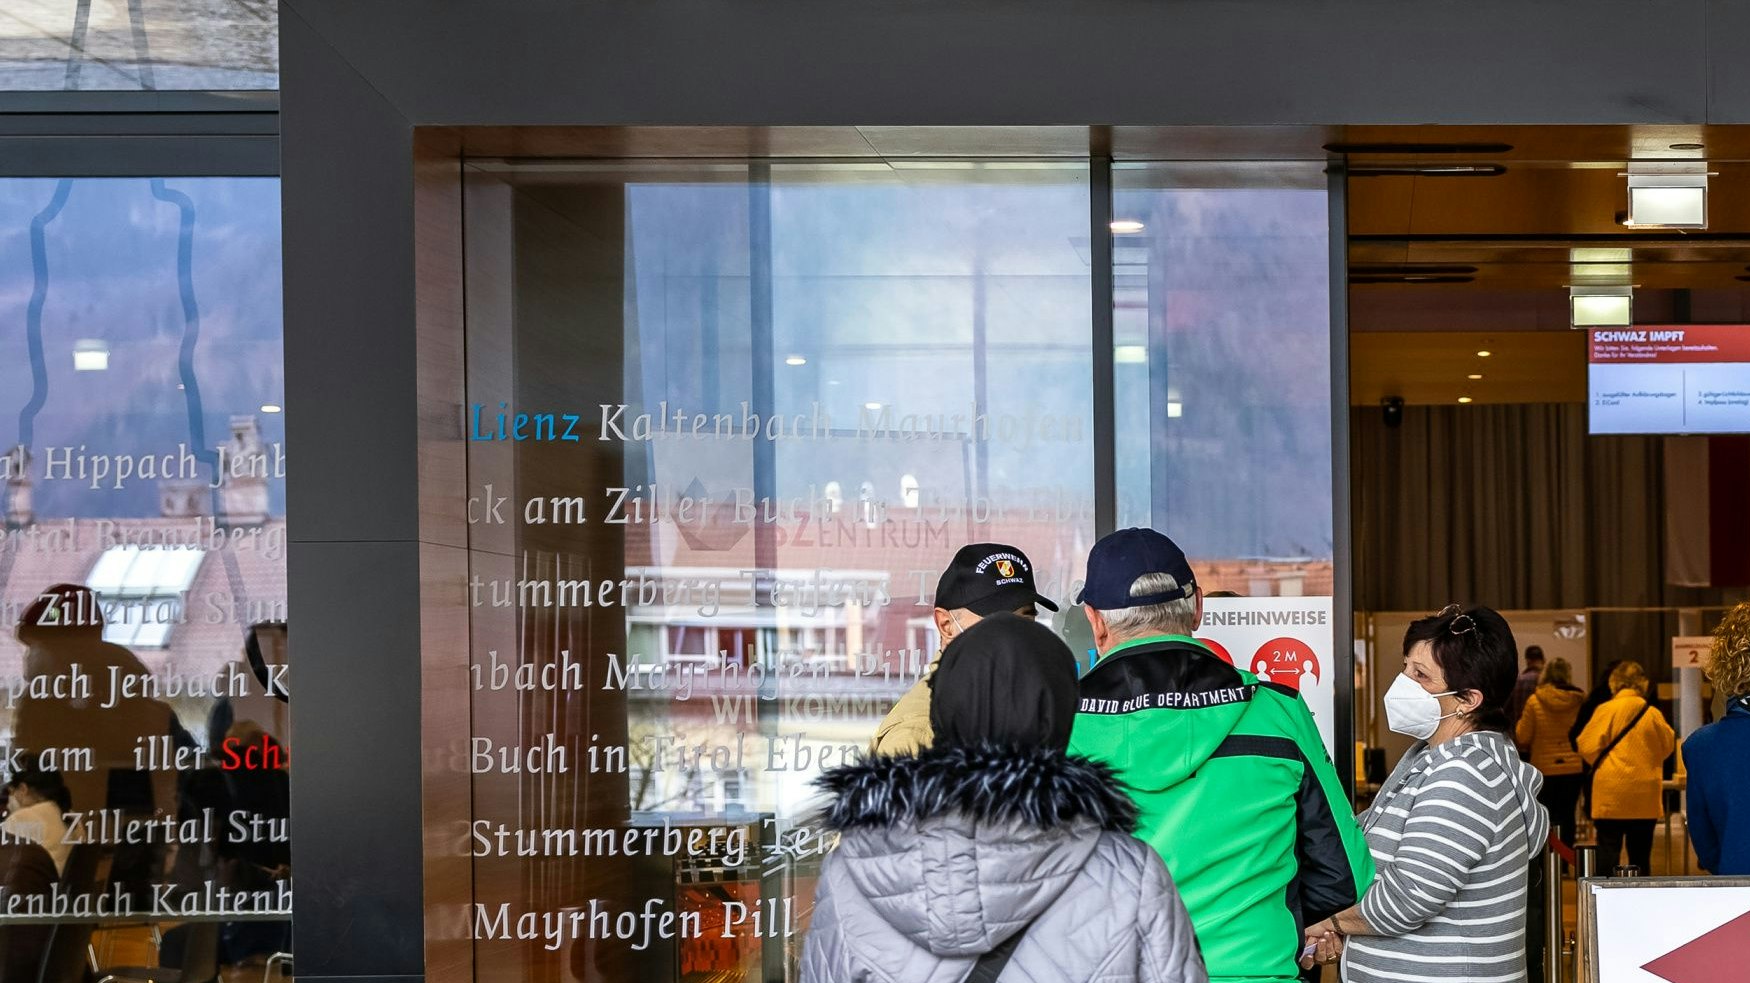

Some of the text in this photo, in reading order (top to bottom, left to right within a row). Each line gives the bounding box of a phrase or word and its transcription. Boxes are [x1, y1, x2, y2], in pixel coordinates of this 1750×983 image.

[1594, 331, 1684, 342] SCHWAZ IMPFT
[470, 402, 1083, 452] Lienz Kaltenbach Mayrhofen
[44, 444, 197, 490] Hippach
[524, 492, 586, 525] am
[604, 486, 714, 525] Ziller
[732, 485, 833, 525] Buch
[96, 518, 286, 562] Brandberg
[976, 552, 1028, 575] FEUERWEHR
[996, 578, 1024, 586] SCHWAZ
[37, 592, 187, 627] Zillertal
[739, 568, 892, 617] Terfens
[603, 649, 831, 701] Mayrhofen
[1273, 650, 1297, 662] 2 M
[101, 661, 247, 708] Jenbach
[1080, 687, 1246, 714] DAVID BLUE DEPARTMENT
[39, 747, 94, 772] am
[221, 731, 290, 771] Sch
[471, 734, 568, 774] Buch
[588, 736, 628, 774] in
[650, 733, 745, 774] Tirol
[61, 808, 213, 846] Zillertal
[471, 817, 748, 866] Stummerberg
[474, 898, 794, 950] Mayrhofen Pill
